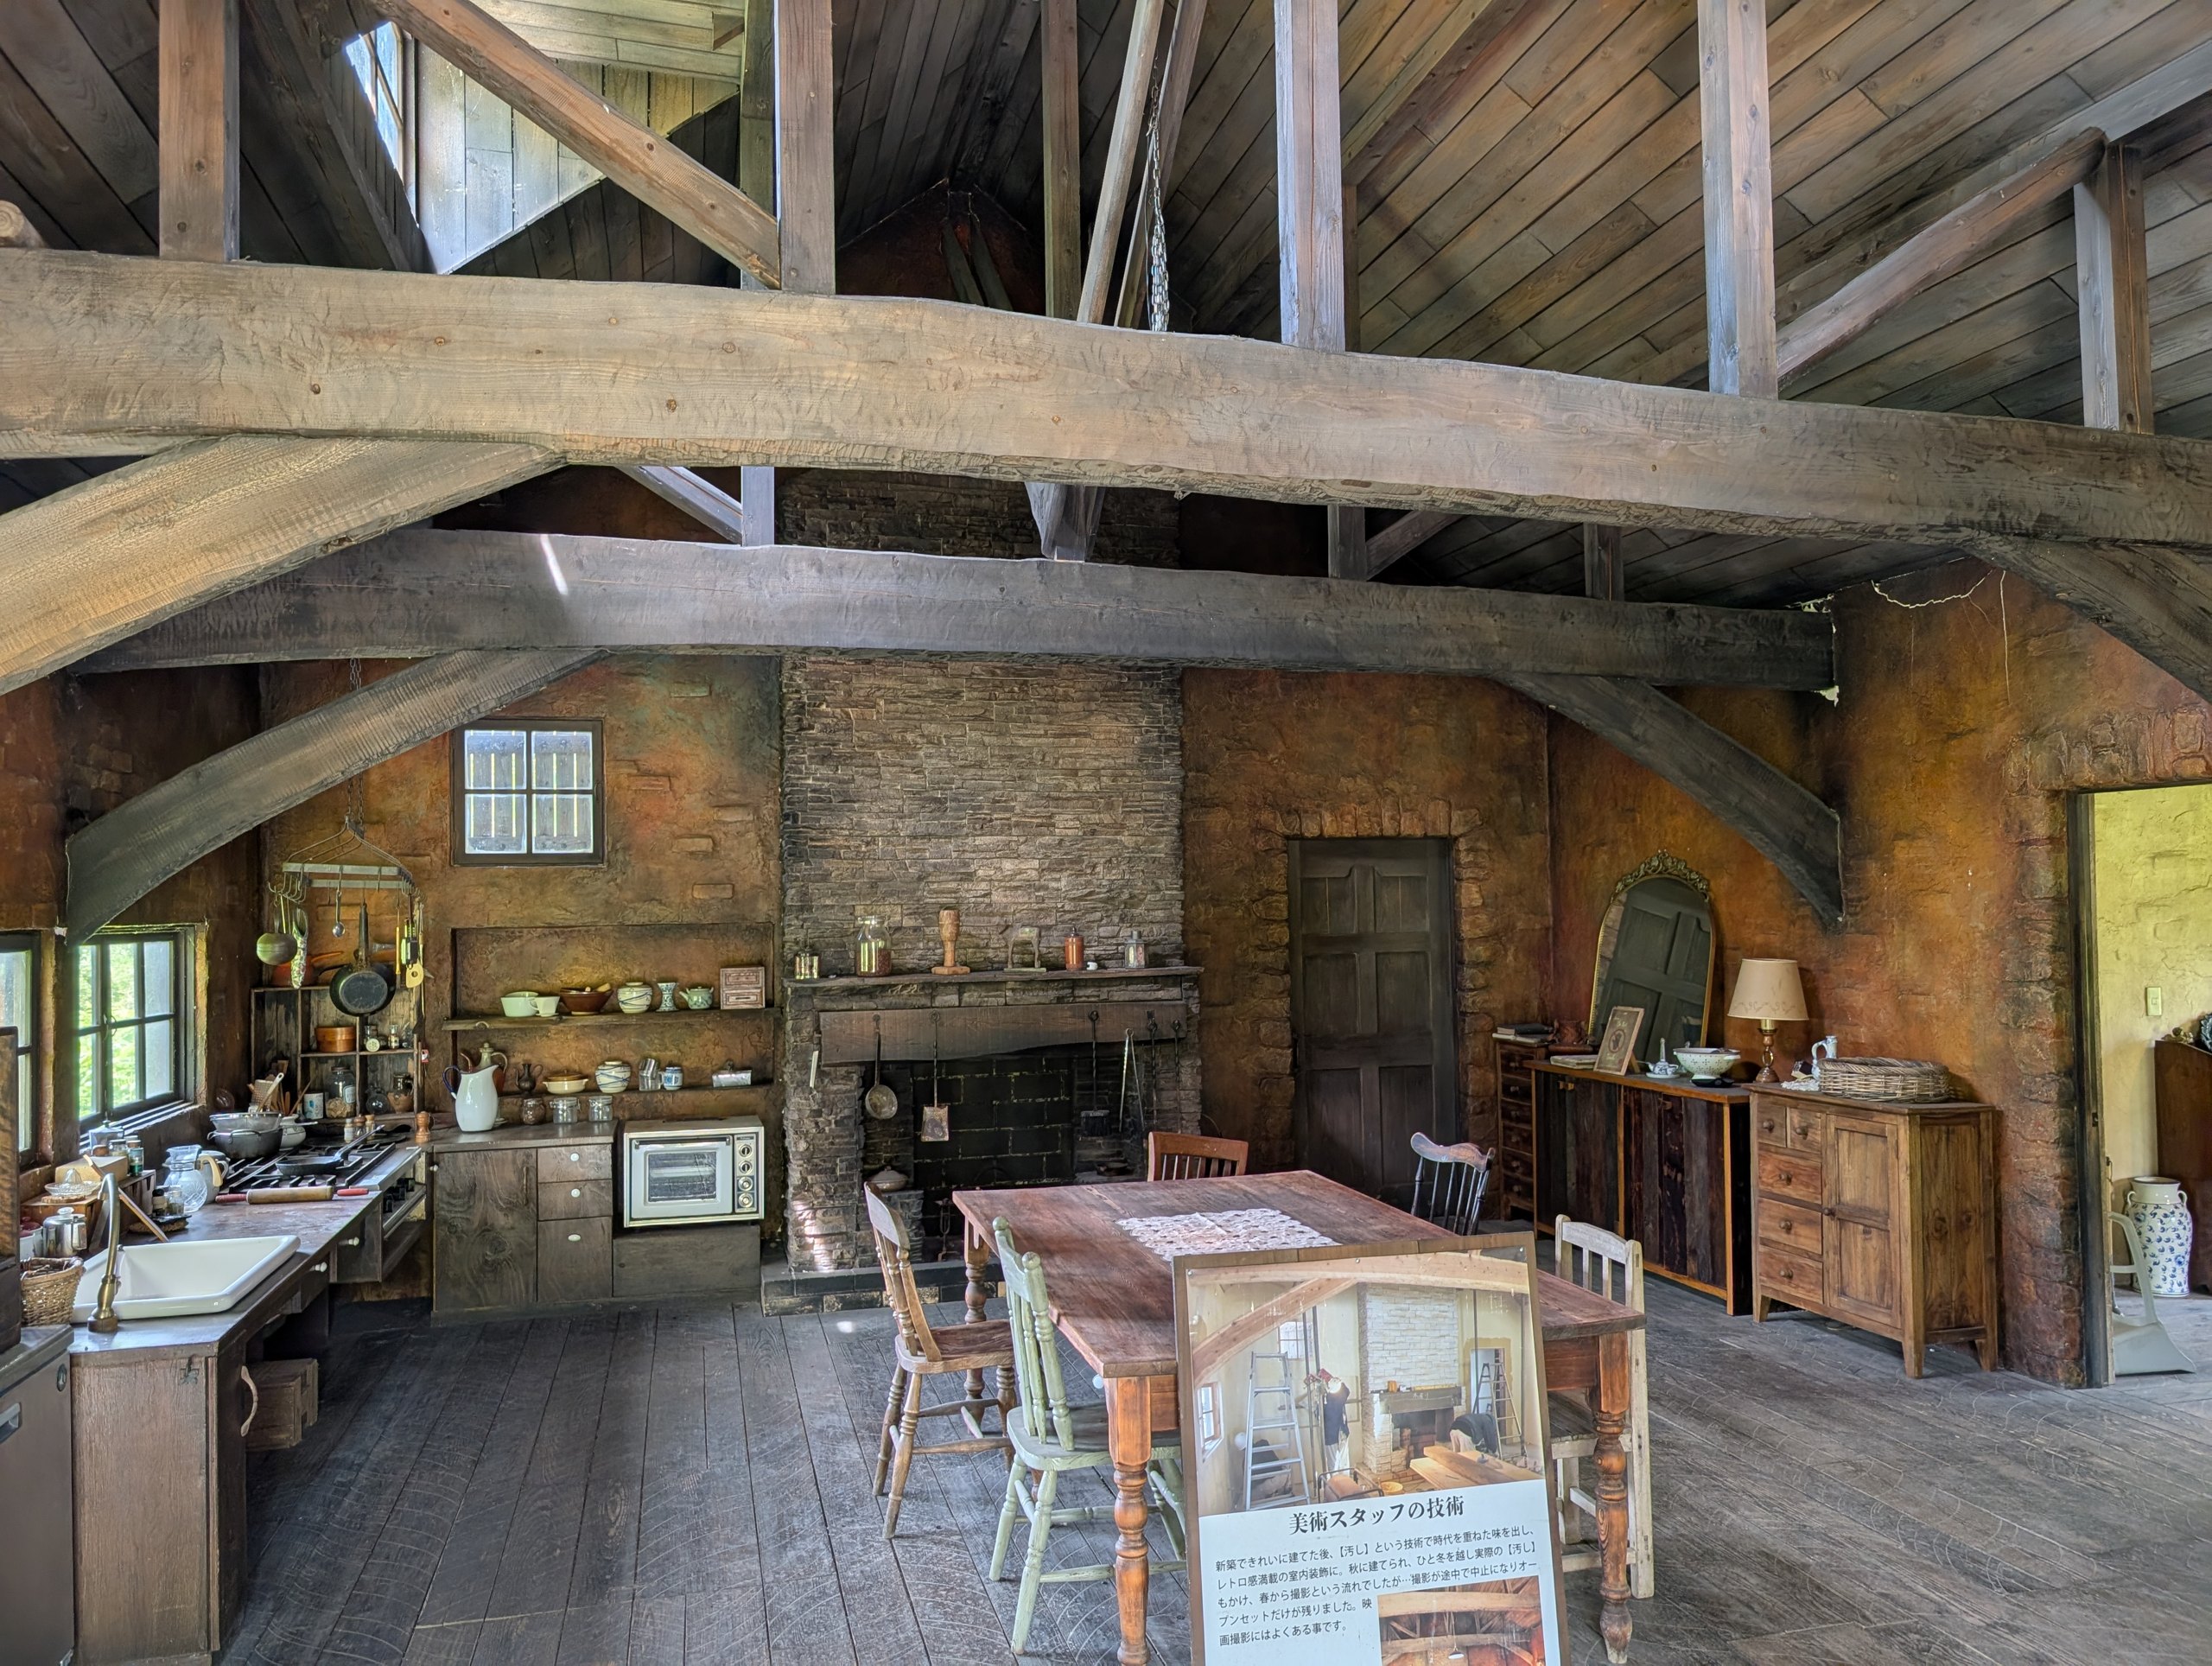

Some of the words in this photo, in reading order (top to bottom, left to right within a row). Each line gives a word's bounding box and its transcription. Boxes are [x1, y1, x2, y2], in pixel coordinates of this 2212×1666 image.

[1289, 1495, 1465, 1535] 美術スタッフの技術
[1219, 1619, 1346, 1646] 画撮影にはよくある事です。
